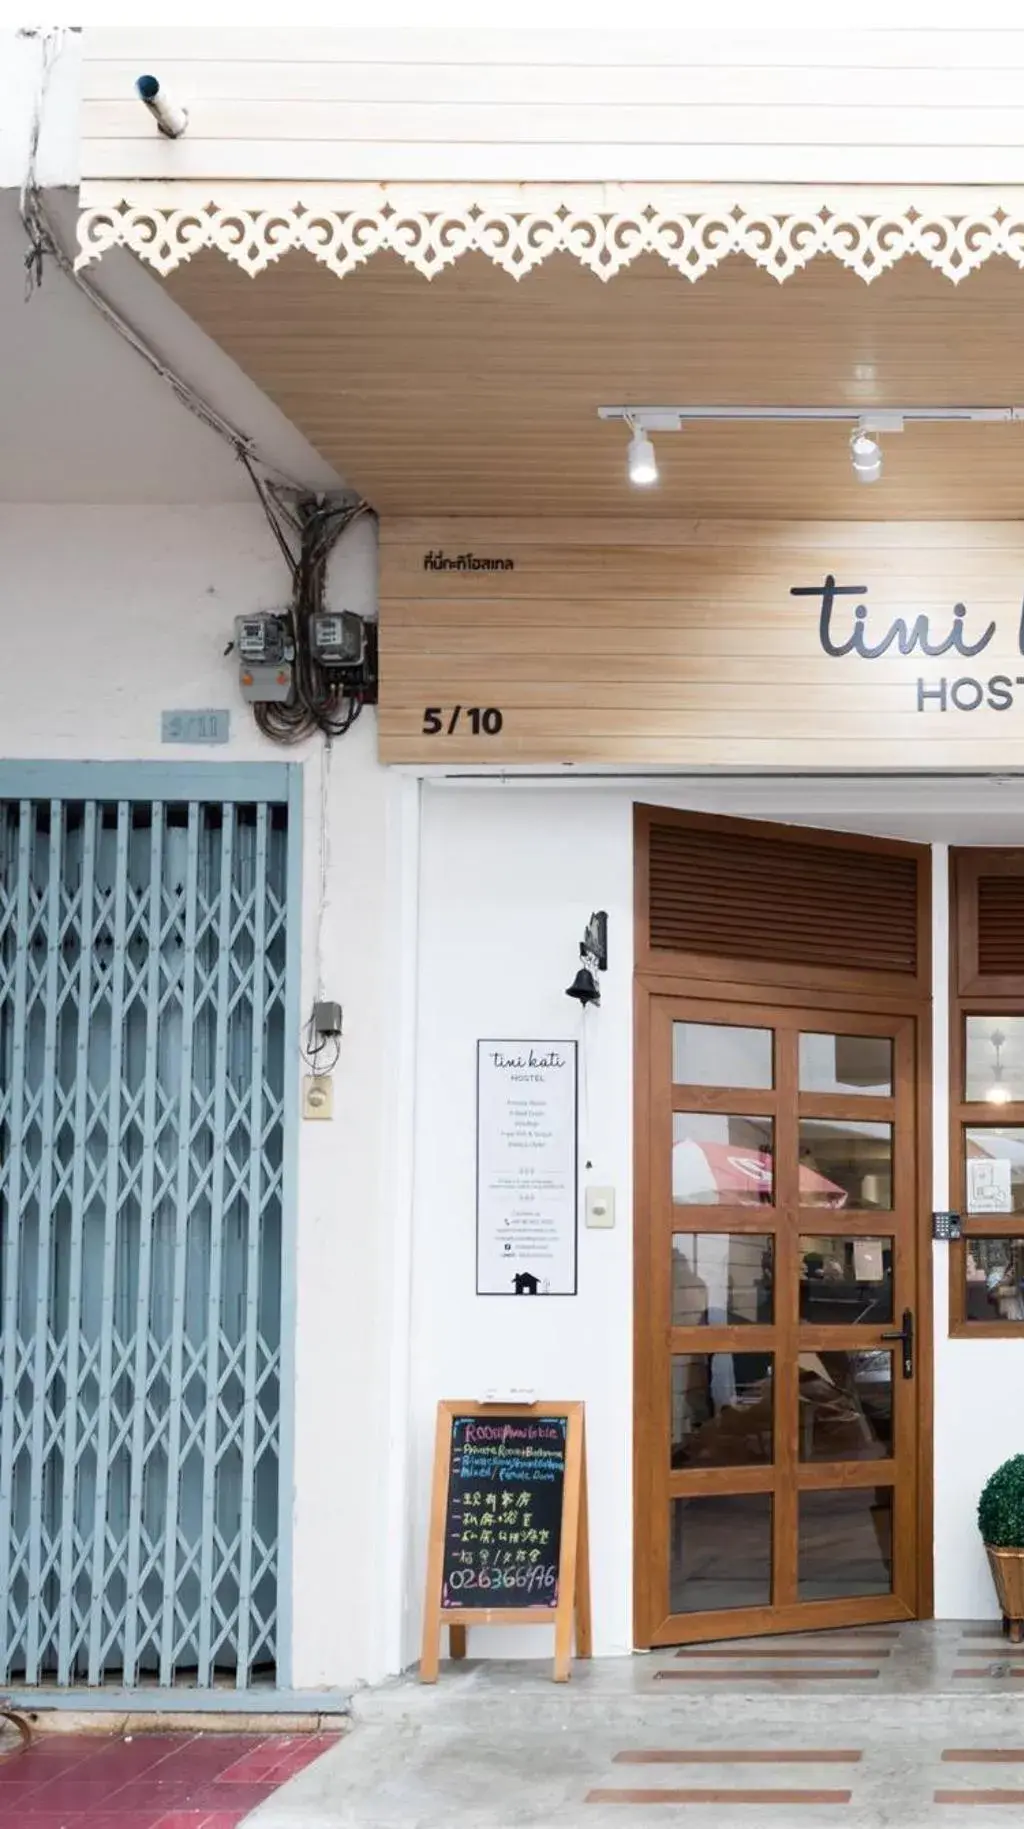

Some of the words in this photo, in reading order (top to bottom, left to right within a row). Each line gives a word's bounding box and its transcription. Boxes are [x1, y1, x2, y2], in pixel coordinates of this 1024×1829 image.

[789, 573, 997, 660] tini
[422, 705, 503, 735] 5/10
[528, 1049, 566, 1068] kati
[510, 1074, 545, 1082] HOSTEL
